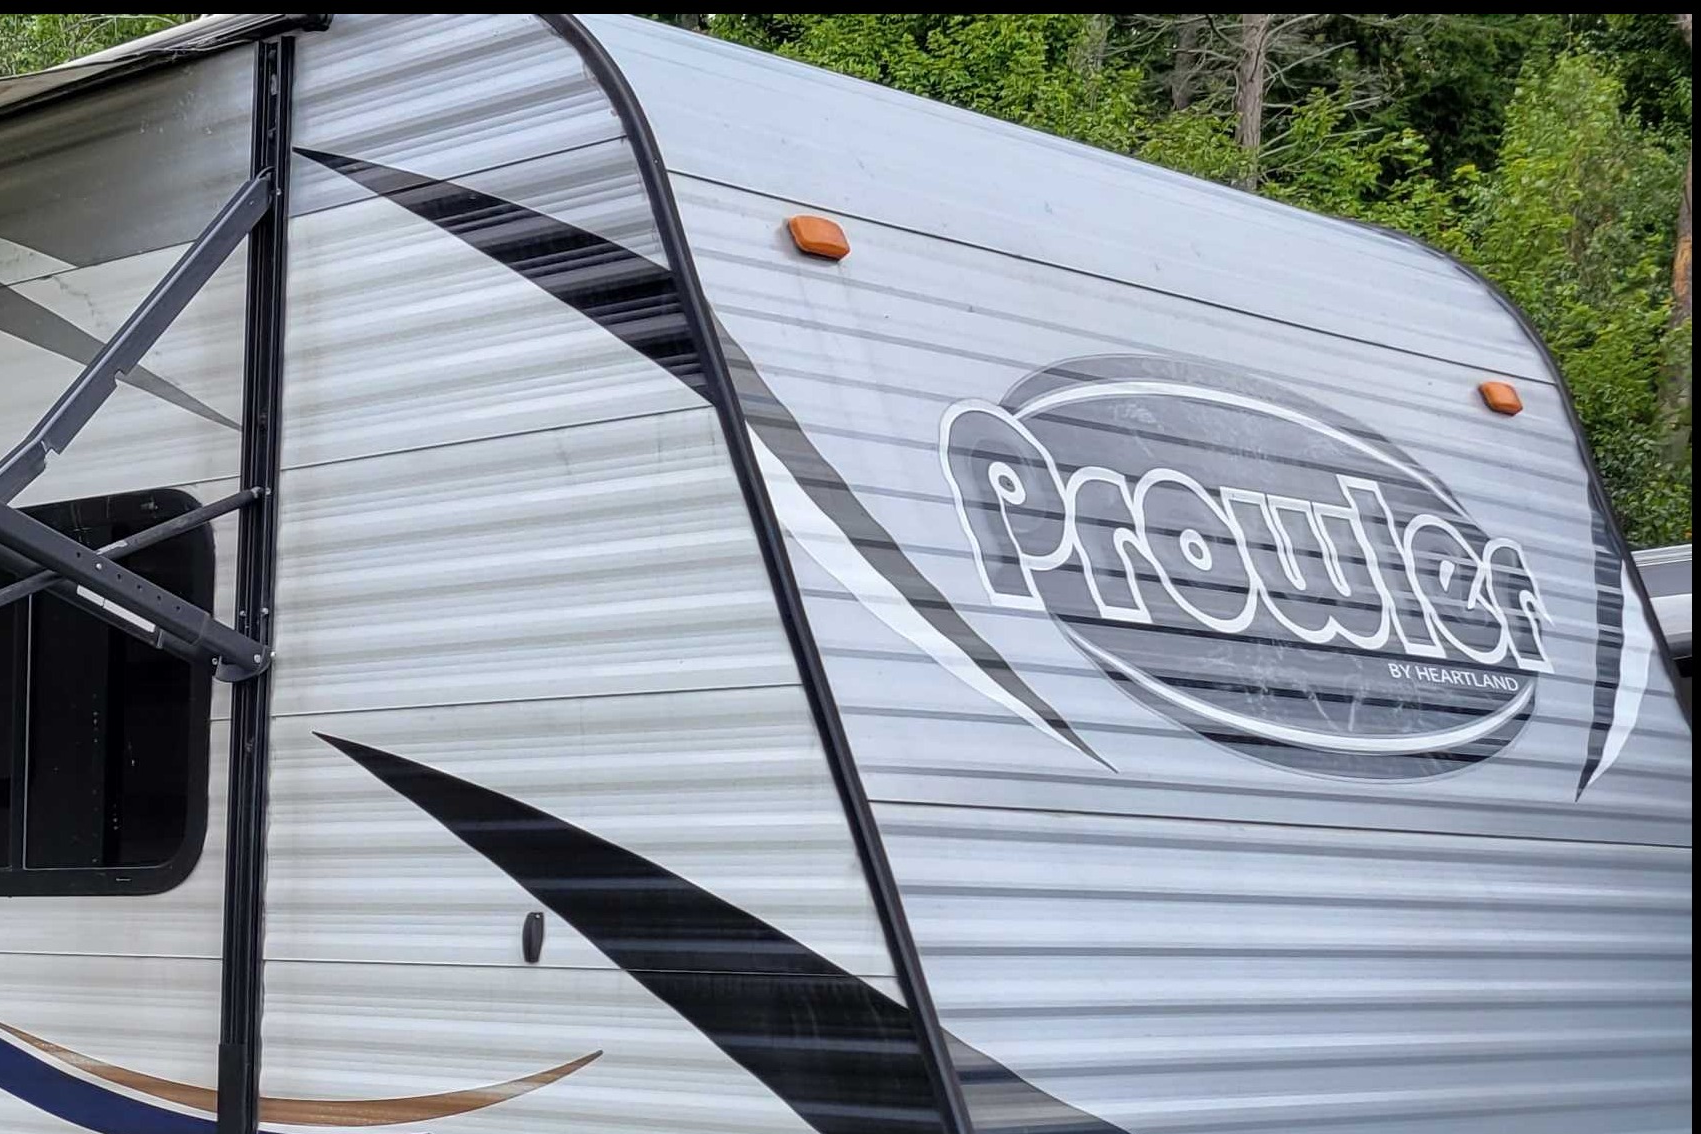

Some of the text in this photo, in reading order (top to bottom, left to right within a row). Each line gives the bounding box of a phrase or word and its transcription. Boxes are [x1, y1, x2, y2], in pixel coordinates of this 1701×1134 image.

[939, 399, 1553, 673] Prowler
[1388, 663, 1519, 692] BY HEARTLAND
